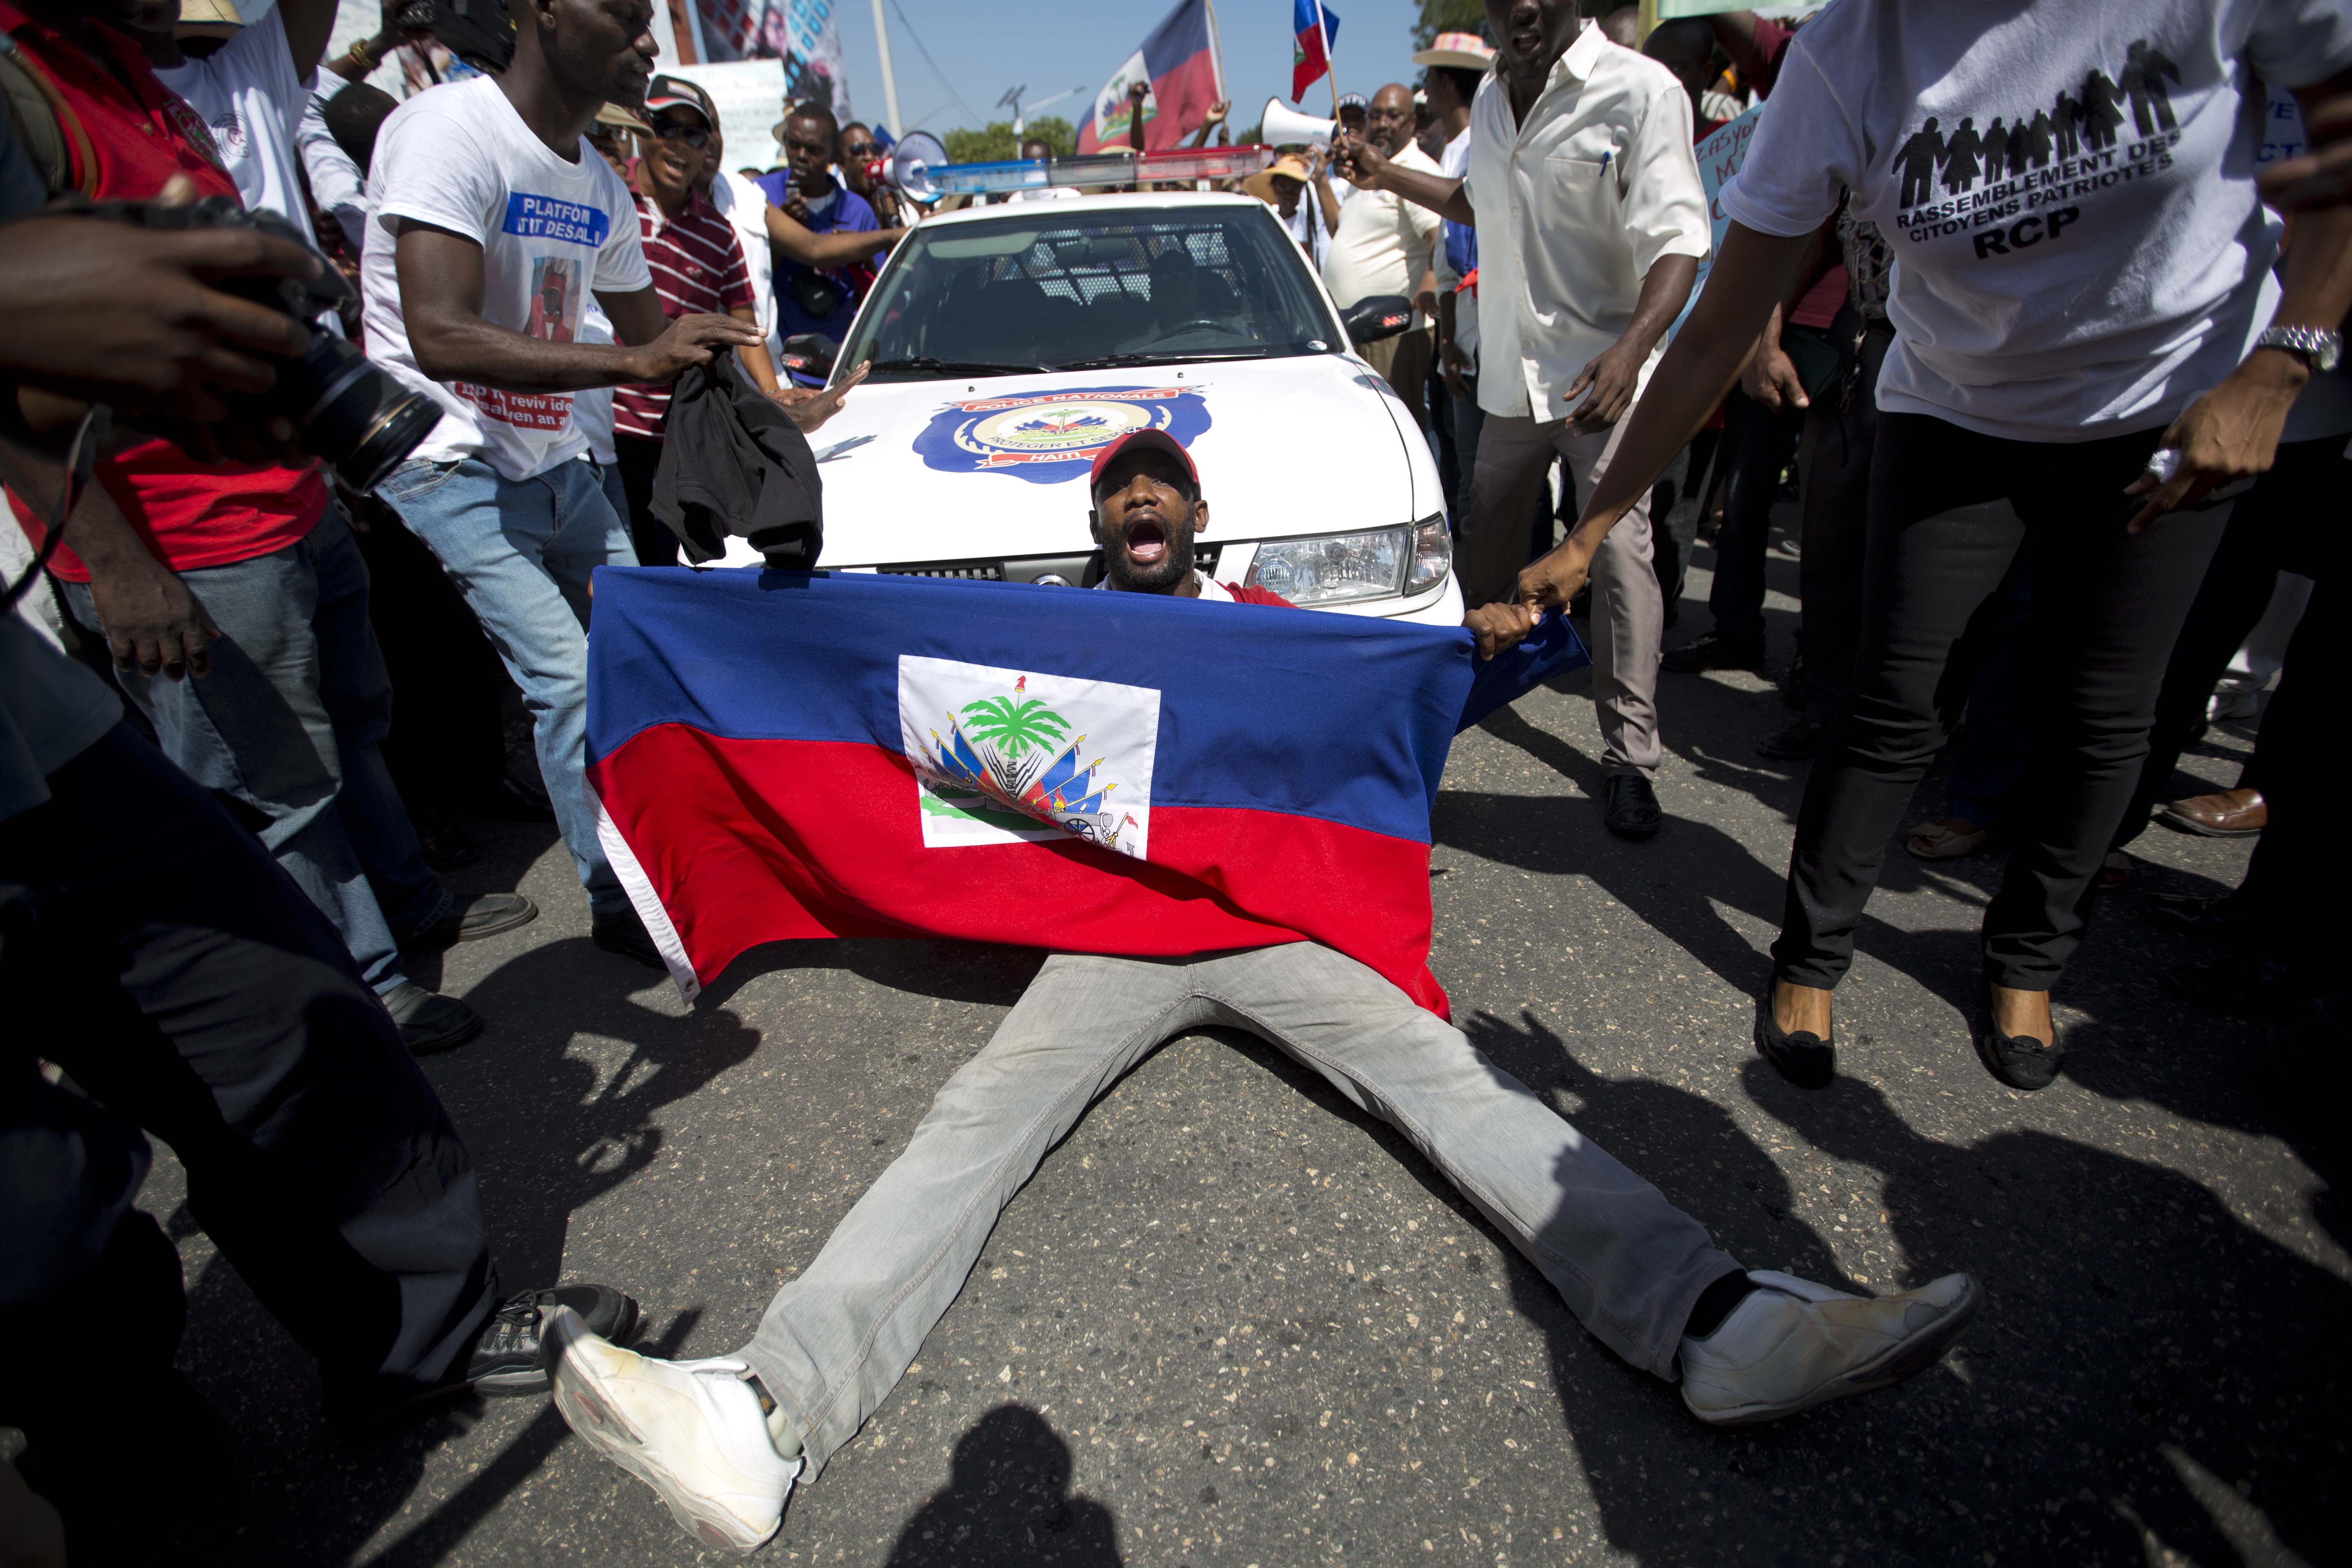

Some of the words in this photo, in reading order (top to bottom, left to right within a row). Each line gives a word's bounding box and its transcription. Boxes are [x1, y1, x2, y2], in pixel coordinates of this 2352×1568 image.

[1896, 149, 2118, 229] RASSEMBLEMENT
[2128, 127, 2181, 160] DES
[1909, 199, 2021, 243] CITOYENS
[2027, 153, 2174, 208] PATRIOTES
[523, 198, 591, 225] PLATFÒM
[1972, 207, 2080, 260] RCP
[511, 395, 546, 410] reviv
[550, 398, 572, 412] ide
[972, 397, 1047, 411] POLICE
[1052, 392, 1167, 401] NATIONALE
[537, 414, 556, 425] an
[986, 436, 1062, 448] PROTEGER
[1029, 451, 1081, 461] HAITI
